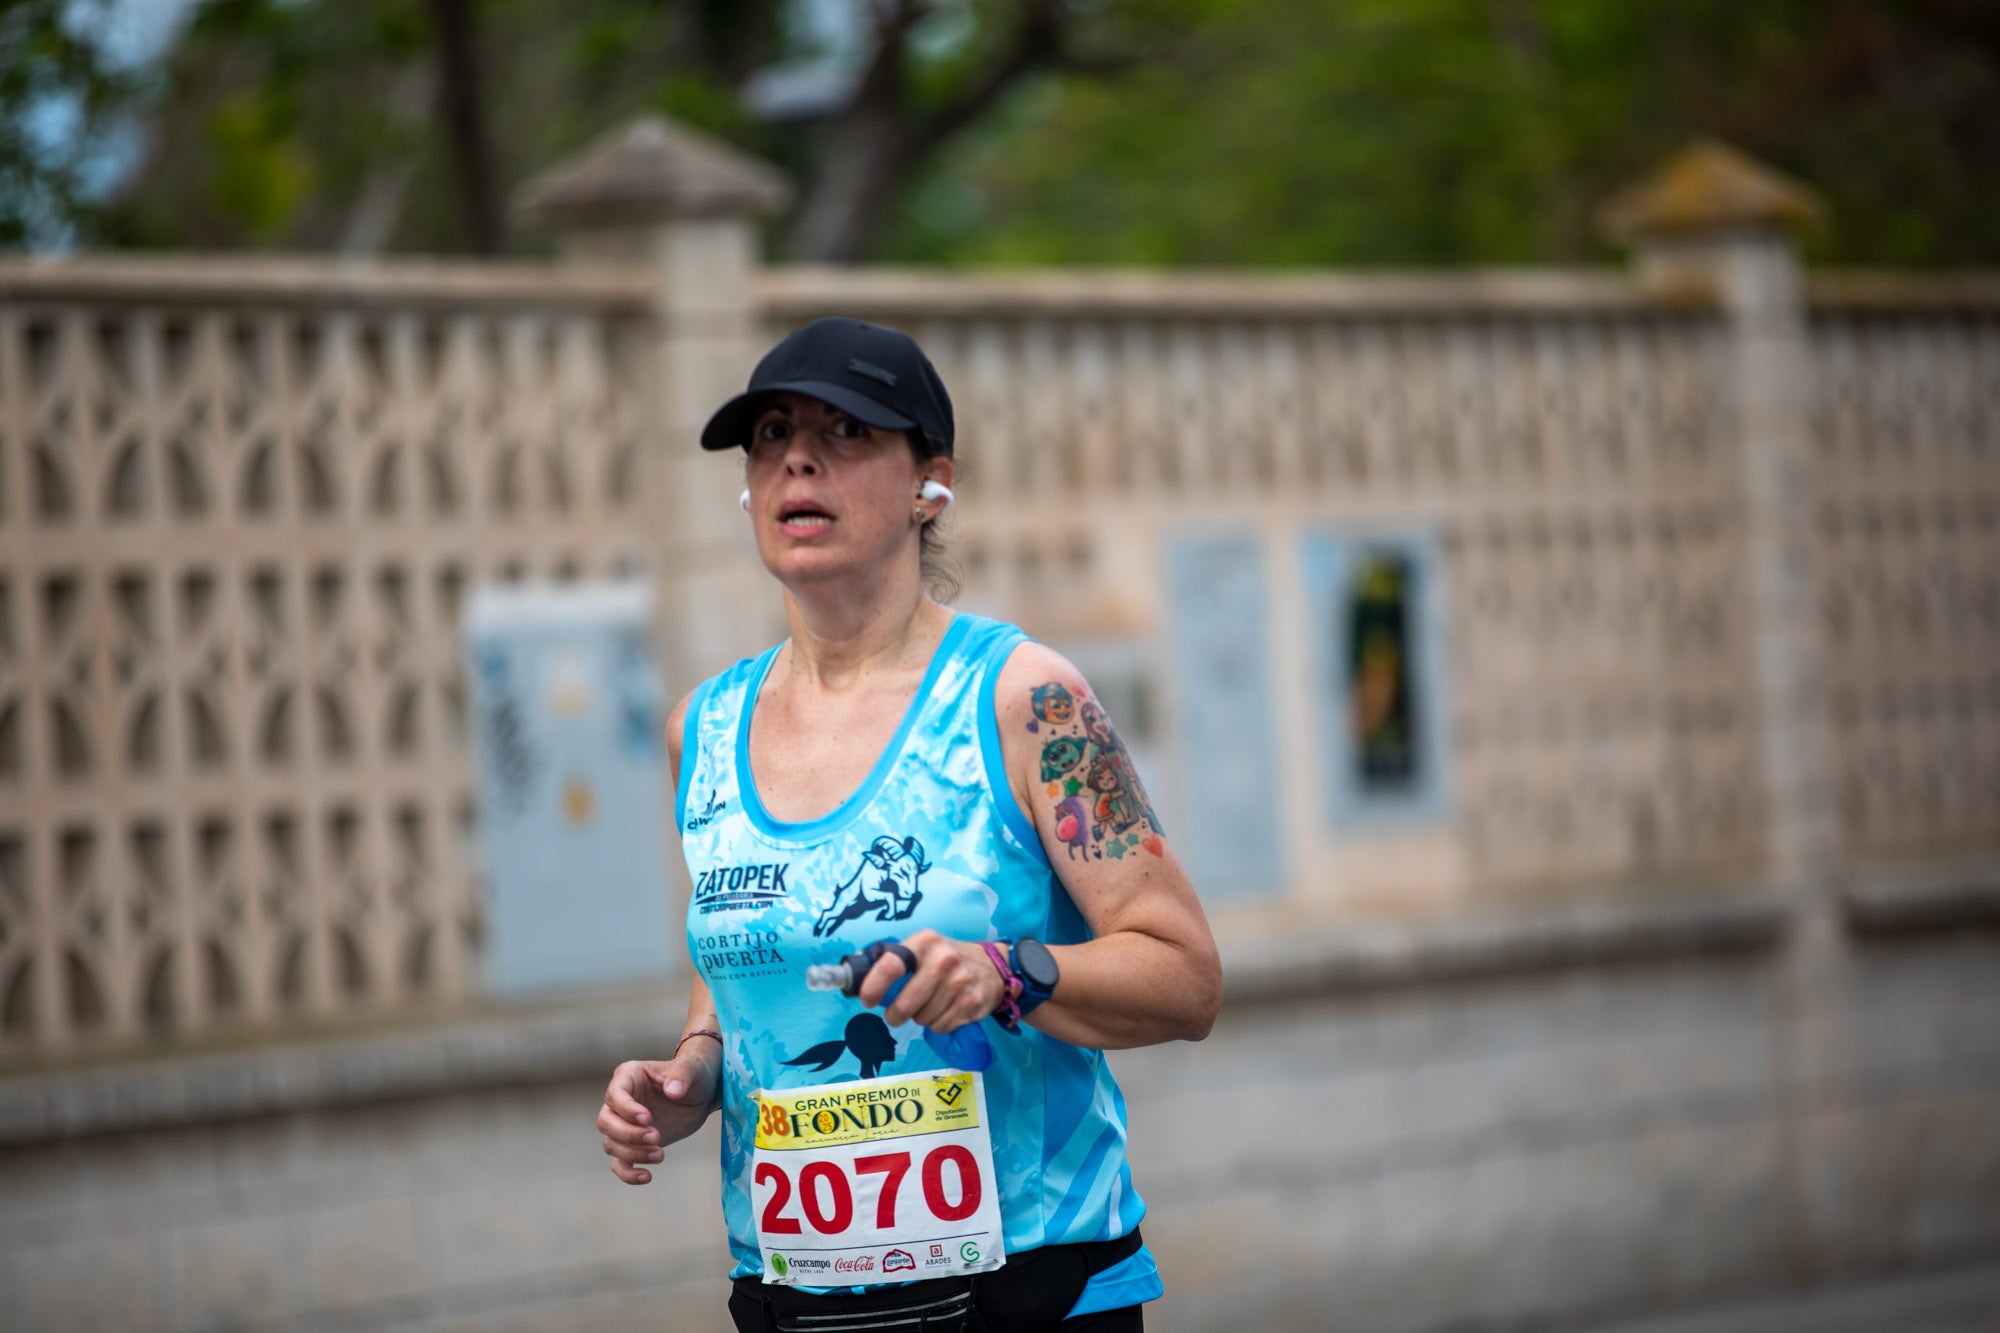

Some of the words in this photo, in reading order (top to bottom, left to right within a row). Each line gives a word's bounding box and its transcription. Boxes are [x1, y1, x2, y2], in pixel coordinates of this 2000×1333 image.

[696, 863, 789, 899] ZATOPEK
[698, 931, 778, 950] CORTIJO
[701, 949, 784, 974] PUERTA
[795, 1095, 841, 1111] GRAN
[846, 1087, 909, 1105] PREMIO
[761, 1103, 789, 1136] 38
[789, 1099, 924, 1138] FONDO
[935, 1107, 968, 1116] Diputación
[944, 1112, 969, 1120] Granada
[755, 1145, 982, 1235] 2070
[788, 1257, 831, 1270] Cruzcampo
[925, 1257, 952, 1266] ABADES
